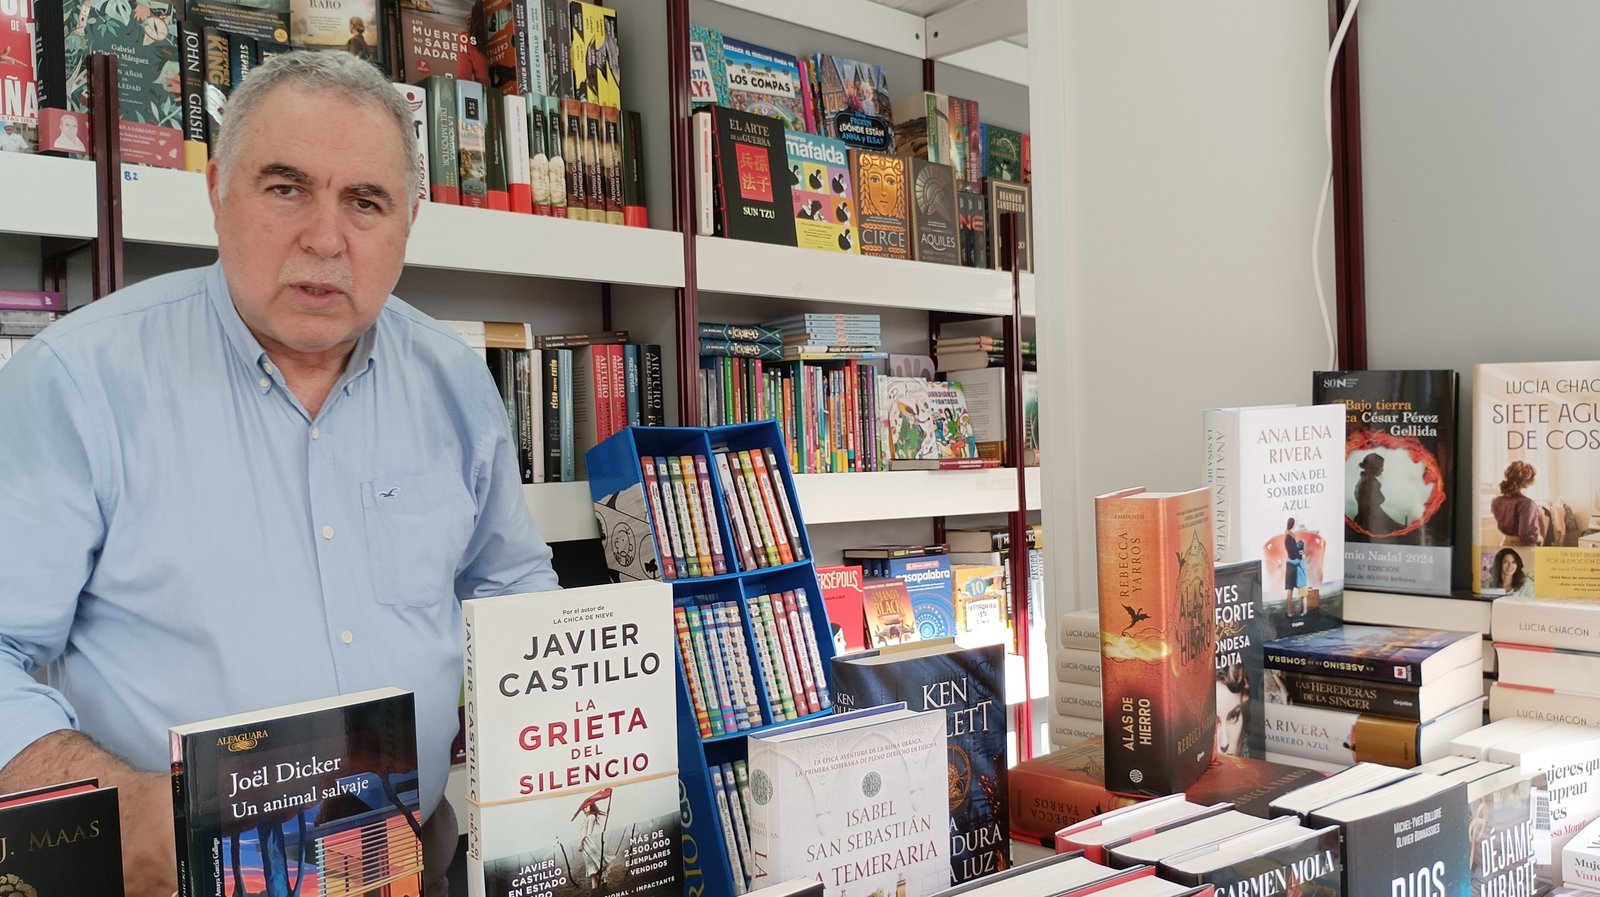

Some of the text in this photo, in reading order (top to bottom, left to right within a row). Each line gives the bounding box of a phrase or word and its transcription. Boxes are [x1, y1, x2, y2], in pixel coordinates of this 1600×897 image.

[11, 20, 20, 31] DE
[412, 25, 477, 46] MUERTOS
[424, 36, 468, 53] SABEN
[111, 44, 136, 54] Gabriel
[183, 29, 200, 73] JOHN
[414, 45, 458, 62] NADAR
[121, 53, 150, 66] Márquez
[207, 34, 221, 85] KING
[519, 31, 529, 92] JAVIER CASTILLO
[534, 34, 543, 92] JAVIER CASTILLO
[691, 68, 707, 80] STÁ
[729, 73, 791, 92] LOS COMPAS
[729, 119, 770, 137] EL ARTE
[440, 123, 449, 167] IMPOSTOR
[742, 134, 771, 147] GUERRA
[785, 137, 845, 166] mafalda
[998, 191, 1022, 203] BRANDON
[743, 205, 775, 220] SUN TZU
[997, 200, 1025, 214] SANDERSON
[862, 229, 905, 248] CIRCE
[920, 233, 956, 251] AQUILES
[601, 355, 609, 399] ARTURO
[617, 355, 626, 398] ARTURO
[652, 353, 662, 409] ARTURO
[1345, 399, 1412, 412] Bajo tierra
[1493, 403, 1549, 424] SIETE
[1361, 411, 1439, 423] César Pérez
[1258, 425, 1332, 445] ANA LENA
[1390, 425, 1437, 437] Gellida
[1507, 430, 1538, 450] DE
[1216, 430, 1226, 464] ANA
[1269, 446, 1322, 464] RIVERA
[1263, 468, 1327, 485] LA NIÑA DEL
[1216, 468, 1226, 507] LENA
[1267, 483, 1324, 498] SOMBRERO
[1281, 499, 1310, 511] AZUL
[1118, 531, 1130, 598] REBECCA
[1131, 537, 1142, 593] YARROS
[1367, 550, 1433, 564] Nadal 2024
[970, 581, 985, 595] 10
[562, 608, 573, 616] Por
[580, 605, 597, 613] autor
[874, 599, 905, 616] BLACK
[563, 615, 583, 624] CHICA
[585, 613, 594, 621] DE
[595, 612, 614, 620] NIEVE
[523, 622, 639, 661] JAVIER
[465, 616, 473, 693] JAVIER
[1267, 654, 1365, 672] ASESINO SOMBRA
[499, 652, 660, 697] CASTILLO
[836, 691, 854, 706] KEN
[922, 677, 967, 711] KEN
[1296, 680, 1377, 699] LAS HEREDERAS
[575, 699, 596, 713] LA
[1303, 692, 1315, 701] DE
[1328, 696, 1370, 711] SINGER
[519, 706, 648, 750] GRIETA
[1122, 696, 1135, 751] ALAS DE
[1138, 698, 1152, 746] HIERRO
[1276, 721, 1329, 739] RIVERA
[216, 729, 269, 746] ALFAGUARA
[1306, 741, 1329, 751] AZUL
[571, 745, 603, 760] DEL
[229, 756, 342, 798] Joël Dicker
[519, 752, 649, 794] SILENCIO
[232, 777, 369, 819] Un animal salvaje
[1034, 797, 1080, 816] YARROS
[846, 800, 897, 827] ISABEL
[28, 820, 101, 852] MAAS
[629, 829, 664, 846] MÁS DE
[807, 815, 932, 863] SAN SEBASTIÁN
[212, 837, 221, 859] Gallego
[624, 838, 671, 857] 2.500.000
[1481, 819, 1536, 878] DÉJAME
[519, 859, 555, 876] JAVIER
[625, 849, 671, 869] EJEMPLARES
[630, 860, 668, 876] VENDIDOS
[755, 850, 768, 878] LA
[832, 840, 938, 886] TEMERARIA
[963, 850, 995, 880] LUZ
[512, 868, 562, 888] CASTILLO
[1214, 850, 1336, 897] CARMEN MOLA
[508, 876, 567, 897] EN ESTADO
[636, 875, 676, 893] IMPACTANTE
